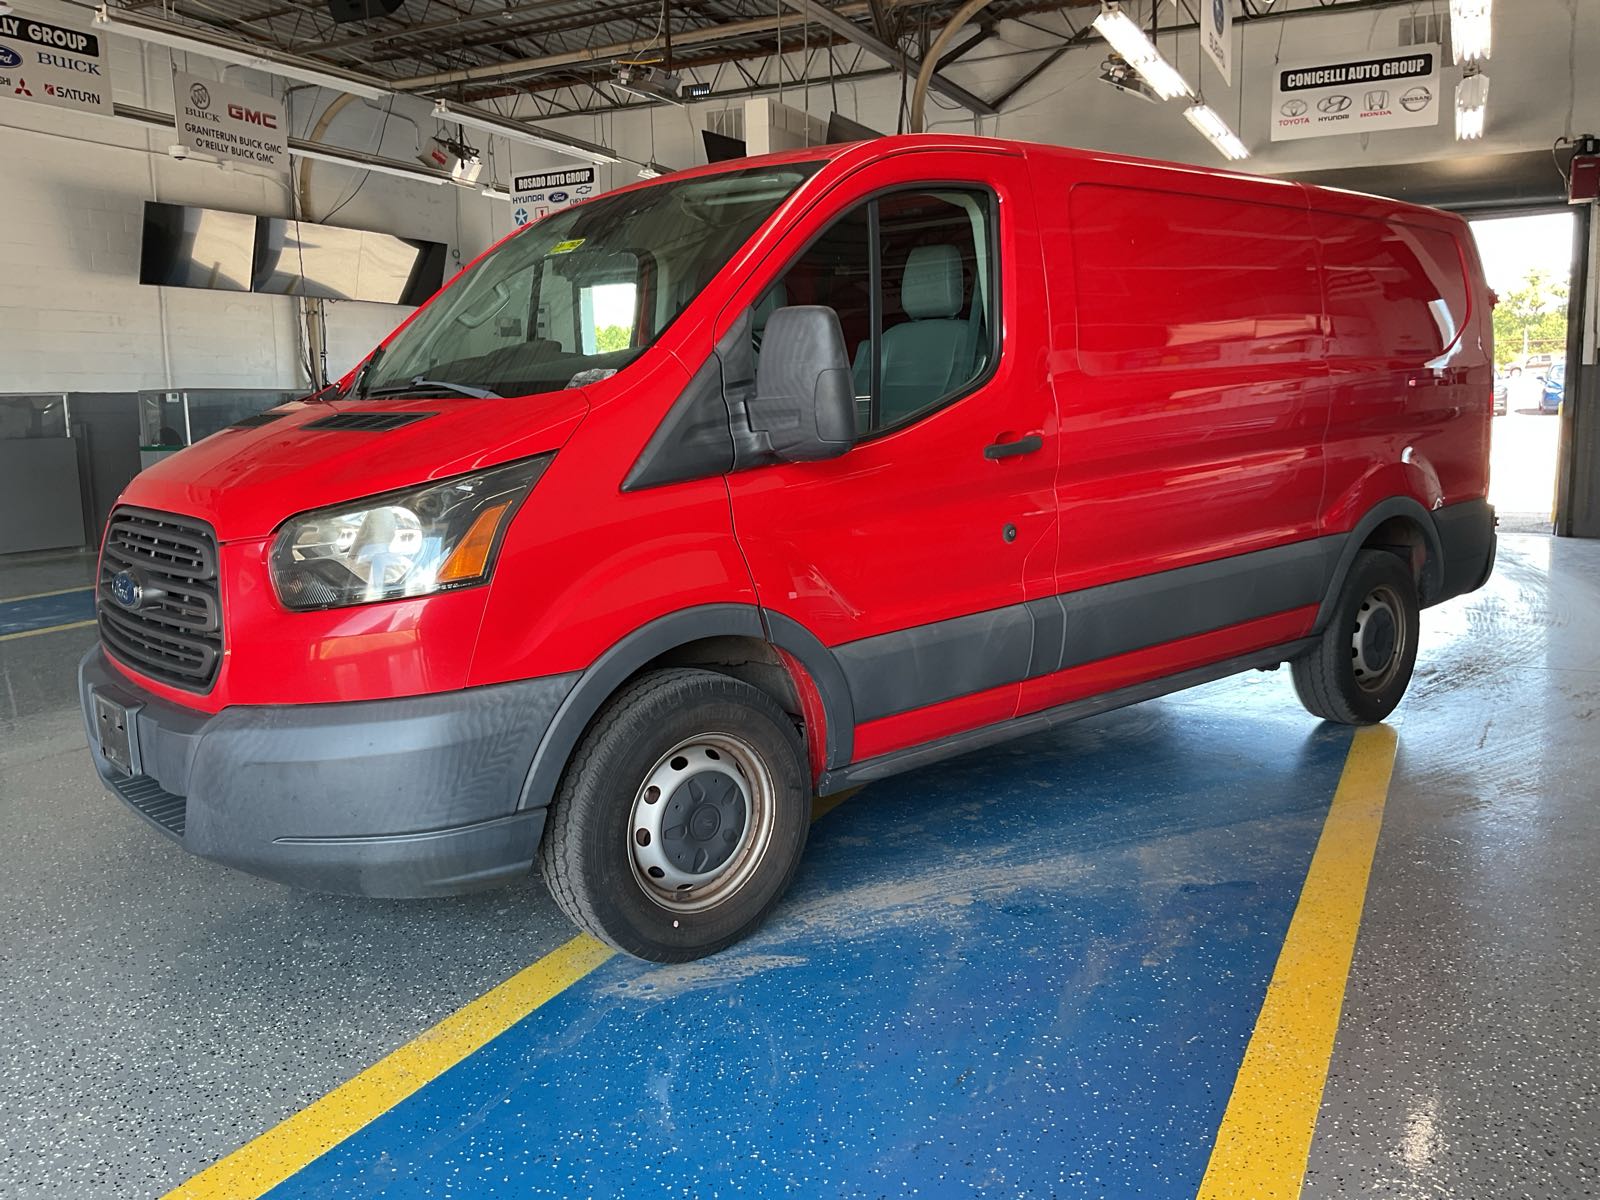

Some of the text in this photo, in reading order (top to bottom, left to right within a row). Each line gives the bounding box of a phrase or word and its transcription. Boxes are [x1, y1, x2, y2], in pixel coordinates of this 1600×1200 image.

[28, 24, 88, 51] GROUP
[37, 51, 102, 77] BUICK
[1287, 58, 1425, 88] CONICELLI AUTO GROUP
[57, 85, 101, 105] SATURN
[1401, 95, 1432, 103] NISSAN
[185, 106, 221, 123] BUICK
[227, 103, 278, 129] GMC
[1278, 117, 1310, 127] TOYOTA
[1318, 114, 1350, 122] HYUNDAI
[1360, 110, 1393, 119] HONDA
[184, 122, 283, 154] GRANITERUN BUICK GMC
[195, 137, 275, 165] O'REILLY BUICK GMC
[518, 170, 591, 190] ROSADO AUTO GROUP
[512, 194, 545, 205] HYUNDAI
[550, 192, 566, 203] Ford
